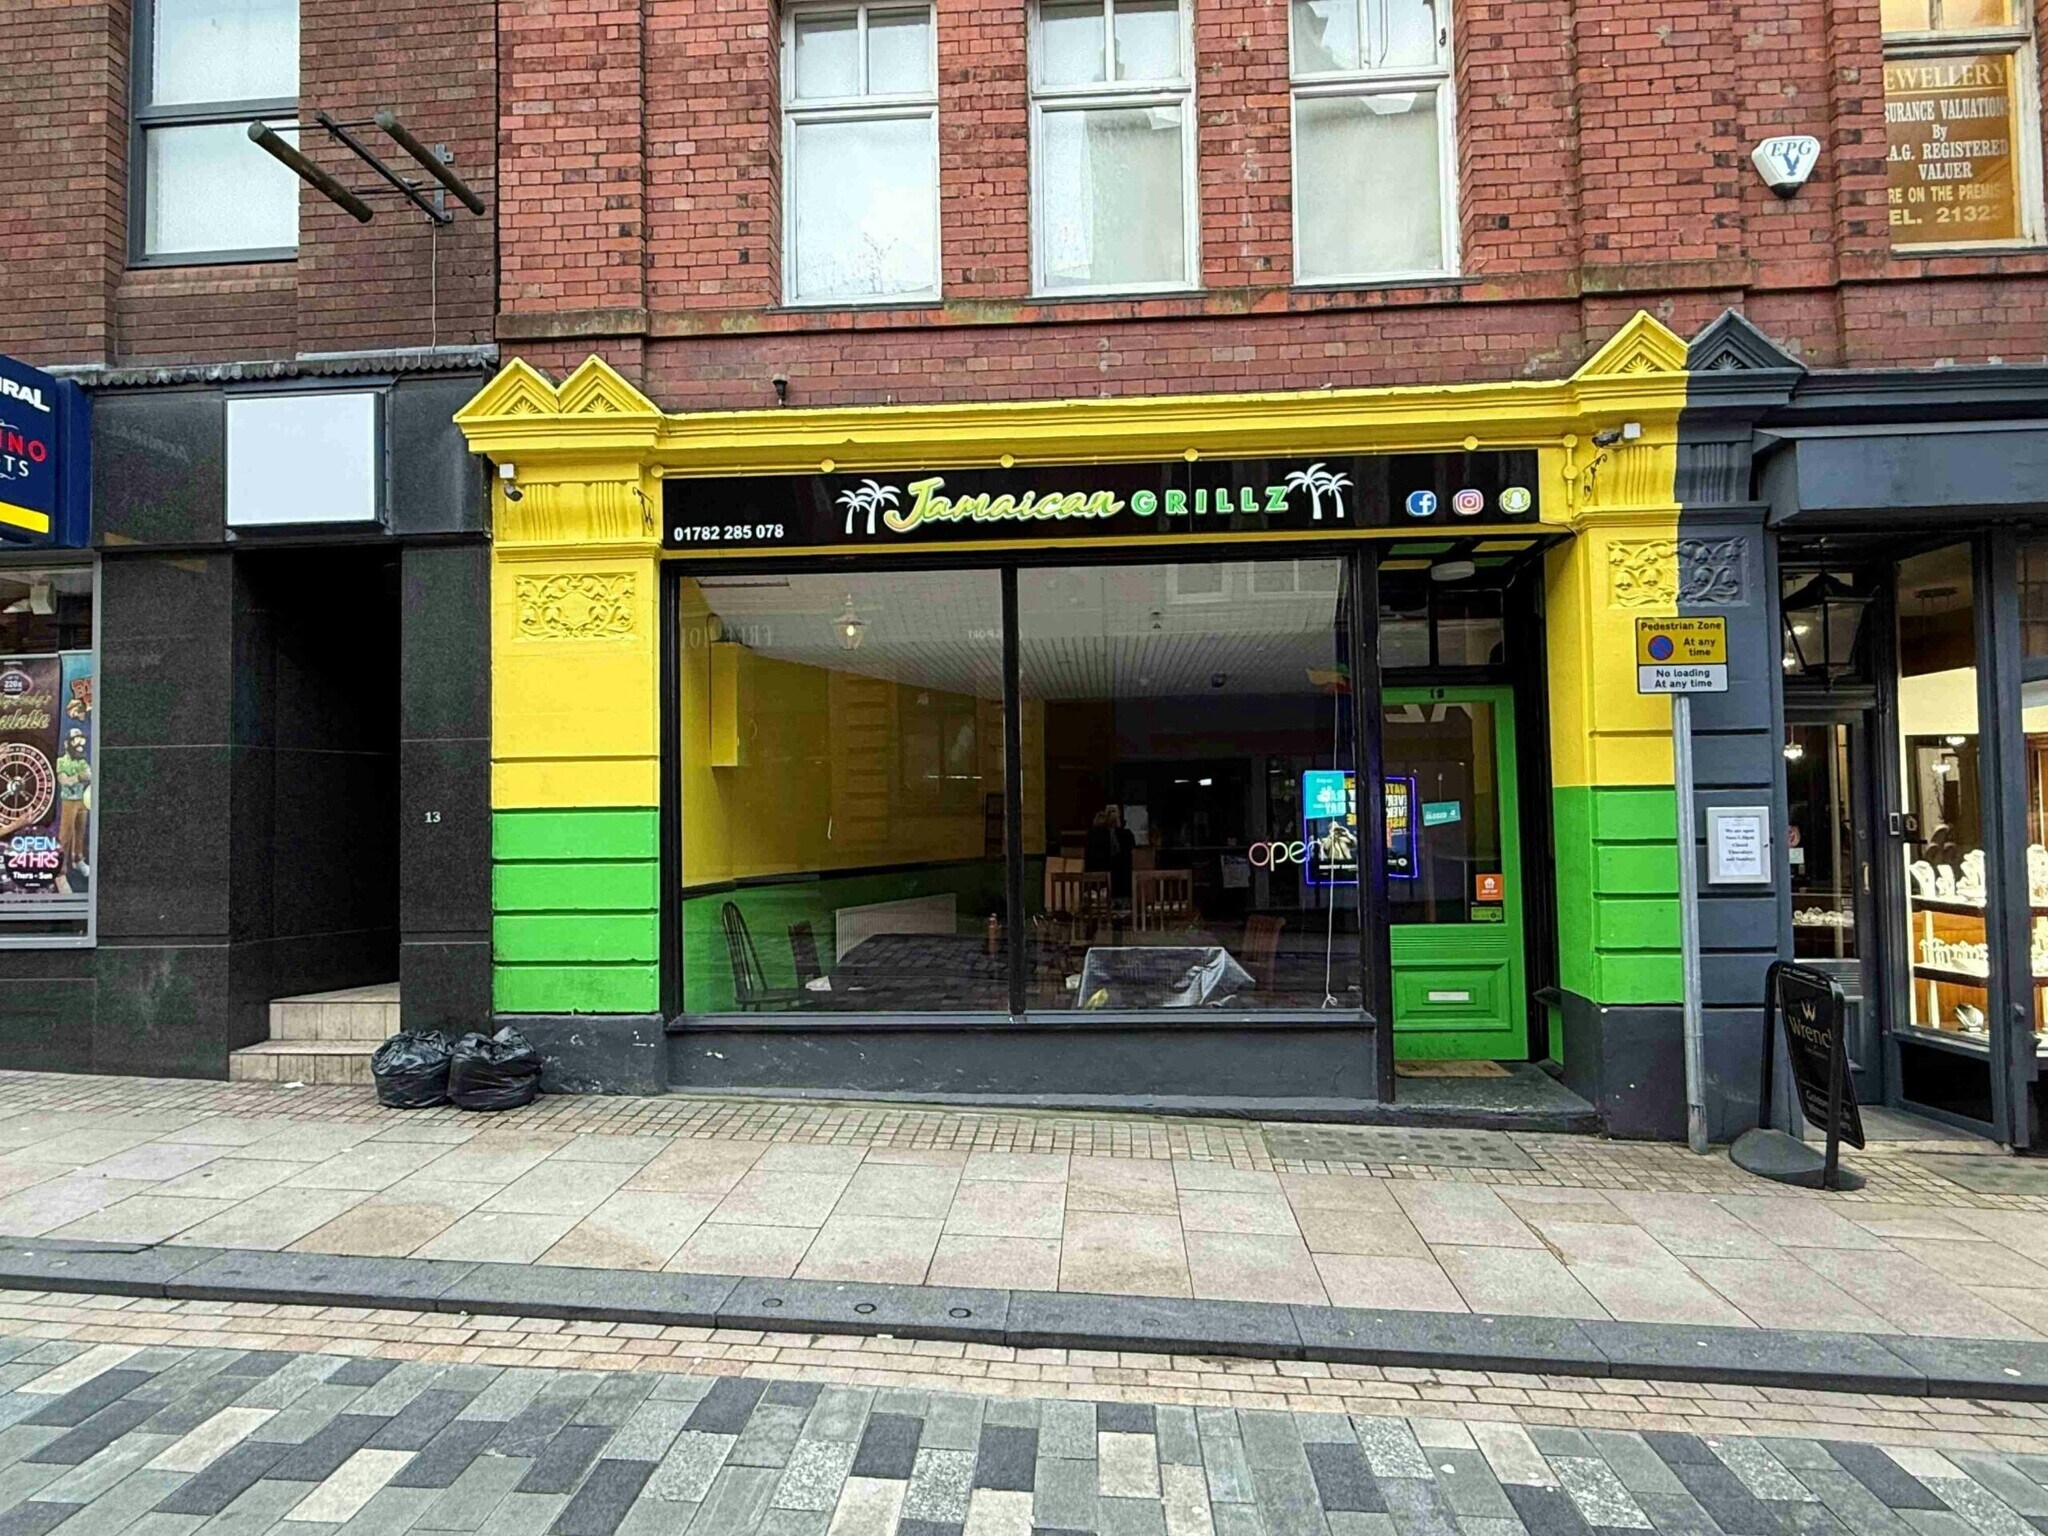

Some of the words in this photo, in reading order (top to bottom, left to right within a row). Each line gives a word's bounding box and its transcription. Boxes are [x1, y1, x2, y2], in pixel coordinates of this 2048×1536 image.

[1932, 124, 1948, 141] By
[1770, 140, 1812, 157] EPG
[1922, 139, 2009, 160] REGISTERED
[1918, 161, 1973, 180] VALUER
[1908, 187, 1925, 203] ON
[1930, 185, 1953, 201] THE
[0, 454, 29, 477] TS
[883, 476, 1126, 533] Jamaican
[1131, 486, 1289, 516] GRILLZ
[673, 526, 721, 541] 01782
[724, 525, 752, 540] 285
[756, 524, 784, 538] 078
[1641, 622, 1694, 631] Pedestrian
[1697, 621, 1722, 630] Zone
[1683, 637, 1695, 646] At
[1698, 638, 1716, 647] any
[1689, 647, 1711, 656] time
[1656, 669, 1670, 677] No
[1674, 668, 1710, 678] loading
[1655, 680, 1666, 688] At
[1669, 681, 1687, 689] any
[1690, 679, 1712, 687] time
[425, 811, 441, 823] 13
[11, 836, 56, 851] OPEN
[8, 850, 27, 868] 24
[28, 851, 59, 868] HRS
[1249, 840, 1325, 872] open
